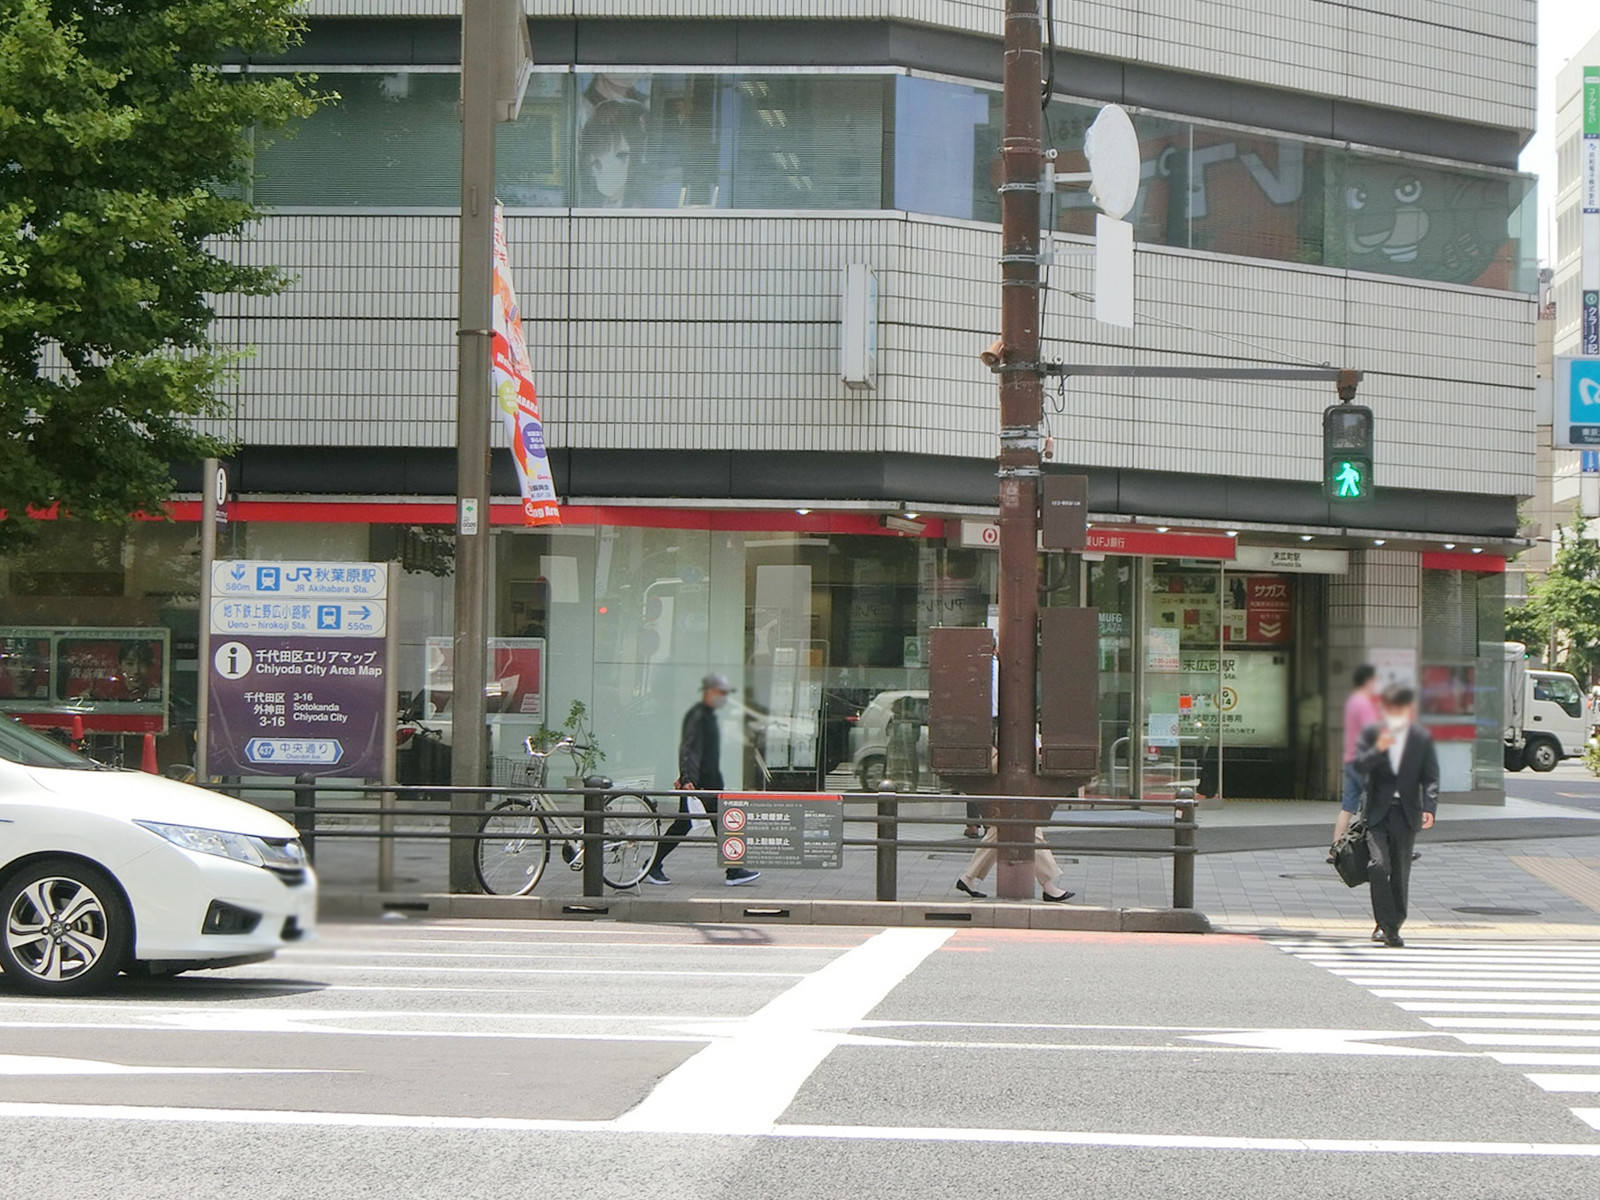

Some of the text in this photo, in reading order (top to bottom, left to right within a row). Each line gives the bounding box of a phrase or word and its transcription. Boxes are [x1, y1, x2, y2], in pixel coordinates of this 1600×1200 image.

[286, 567, 377, 584] JR 秋葉原駅
[225, 583, 250, 591] 580m
[295, 585, 370, 594] JR Akihabara Sta.
[1254, 583, 1287, 598] サガス
[223, 603, 312, 619] 地下鉄上野広小路駅
[1098, 613, 1122, 623] MUFG
[227, 621, 249, 629] Ueno
[257, 621, 289, 631] hirokoji
[291, 621, 308, 630] Sta.
[347, 623, 373, 631] 550m
[255, 650, 377, 664] 千代田区エリアマップ
[256, 664, 383, 677] Chiyoda City Area Map
[244, 692, 286, 703] 千代田区
[293, 693, 313, 701] 3-16
[253, 704, 285, 715] 外神田
[293, 703, 340, 711] Sotokanda
[260, 717, 286, 727] 3-16
[293, 713, 348, 723] Chiyoda City
[279, 743, 328, 754] 中央通り
